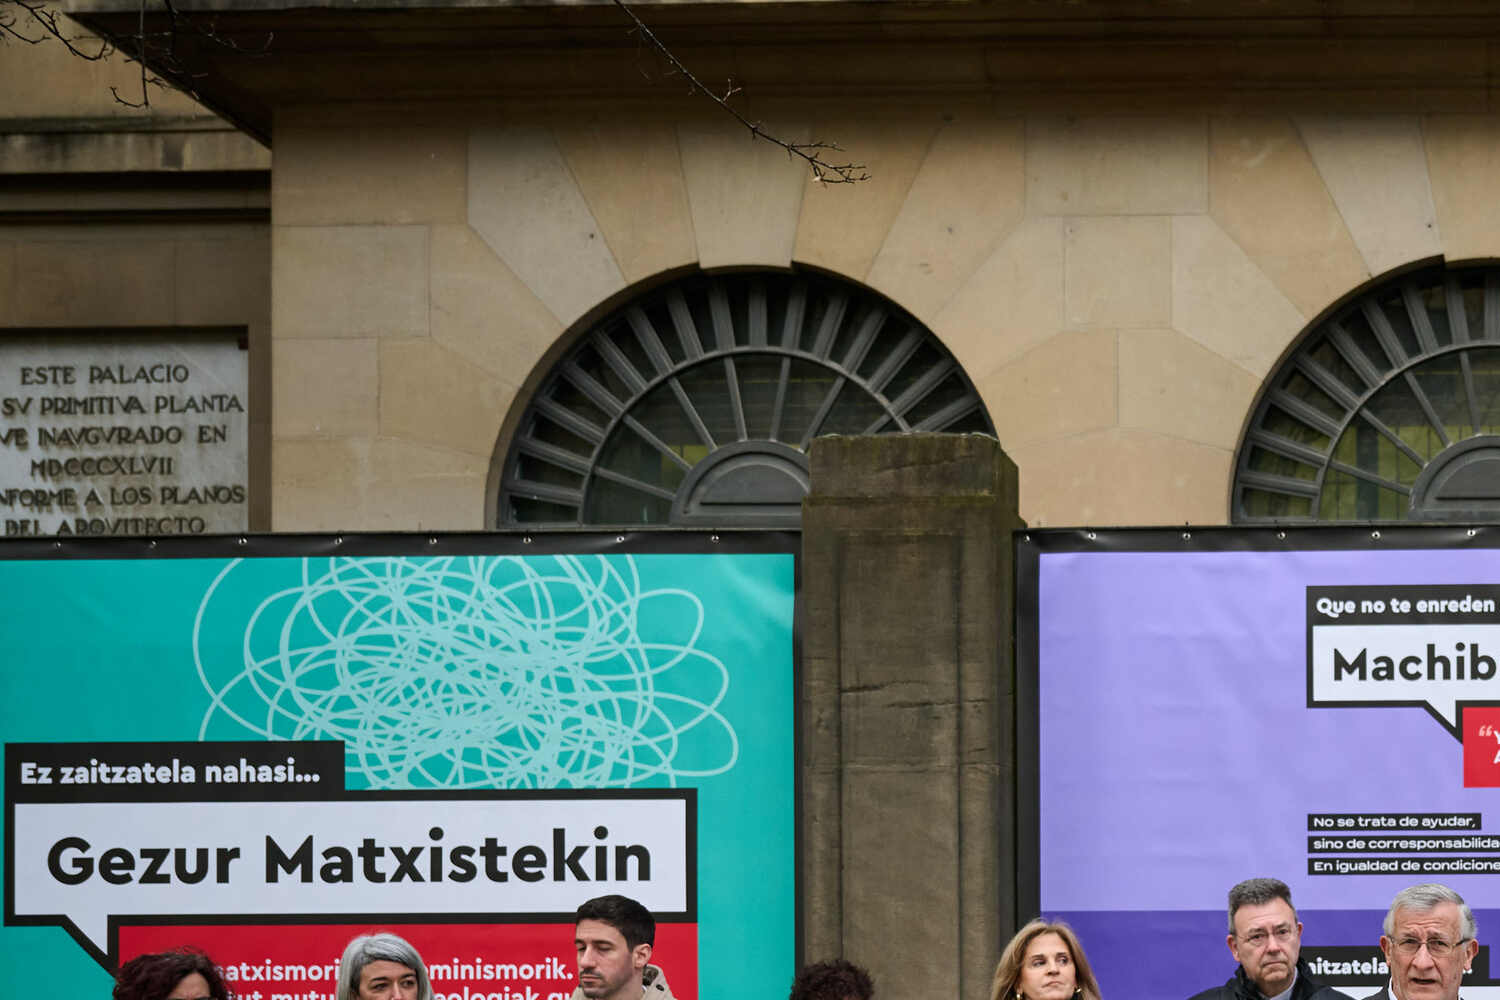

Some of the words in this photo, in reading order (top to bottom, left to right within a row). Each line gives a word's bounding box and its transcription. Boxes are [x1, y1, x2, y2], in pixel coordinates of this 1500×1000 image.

[20, 366, 76, 385] ESTE
[89, 364, 190, 384] PALACIO
[40, 396, 147, 415] PRIMITIVA
[154, 394, 245, 413] PLANTA
[38, 427, 182, 446] INAVGVRADO
[198, 425, 227, 443] EN
[30, 457, 173, 477] MDCCCXLVII
[84, 488, 101, 505] A
[110, 487, 153, 505] LOS
[160, 485, 245, 504] PLANOS
[1316, 597, 1356, 618] Que
[1361, 598, 1386, 614] no
[1390, 597, 1411, 614] te
[1416, 595, 1496, 613] enreden
[21, 762, 53, 785] Ez
[60, 758, 196, 785] zaitzatela
[205, 757, 320, 784] nahasi...
[1313, 817, 1334, 828] No
[1337, 817, 1355, 828] se
[1358, 816, 1397, 827] trata
[1399, 815, 1419, 827] de
[1421, 815, 1477, 829] ayudar,
[1313, 838, 1344, 850] sino
[1346, 838, 1366, 849] de
[47, 836, 241, 886] Gezur
[265, 825, 652, 885] Matxistekin
[1313, 861, 1333, 872] En
[1336, 859, 1399, 874] igualdad
[1401, 859, 1420, 871] de
[428, 957, 574, 980] minismorik.
